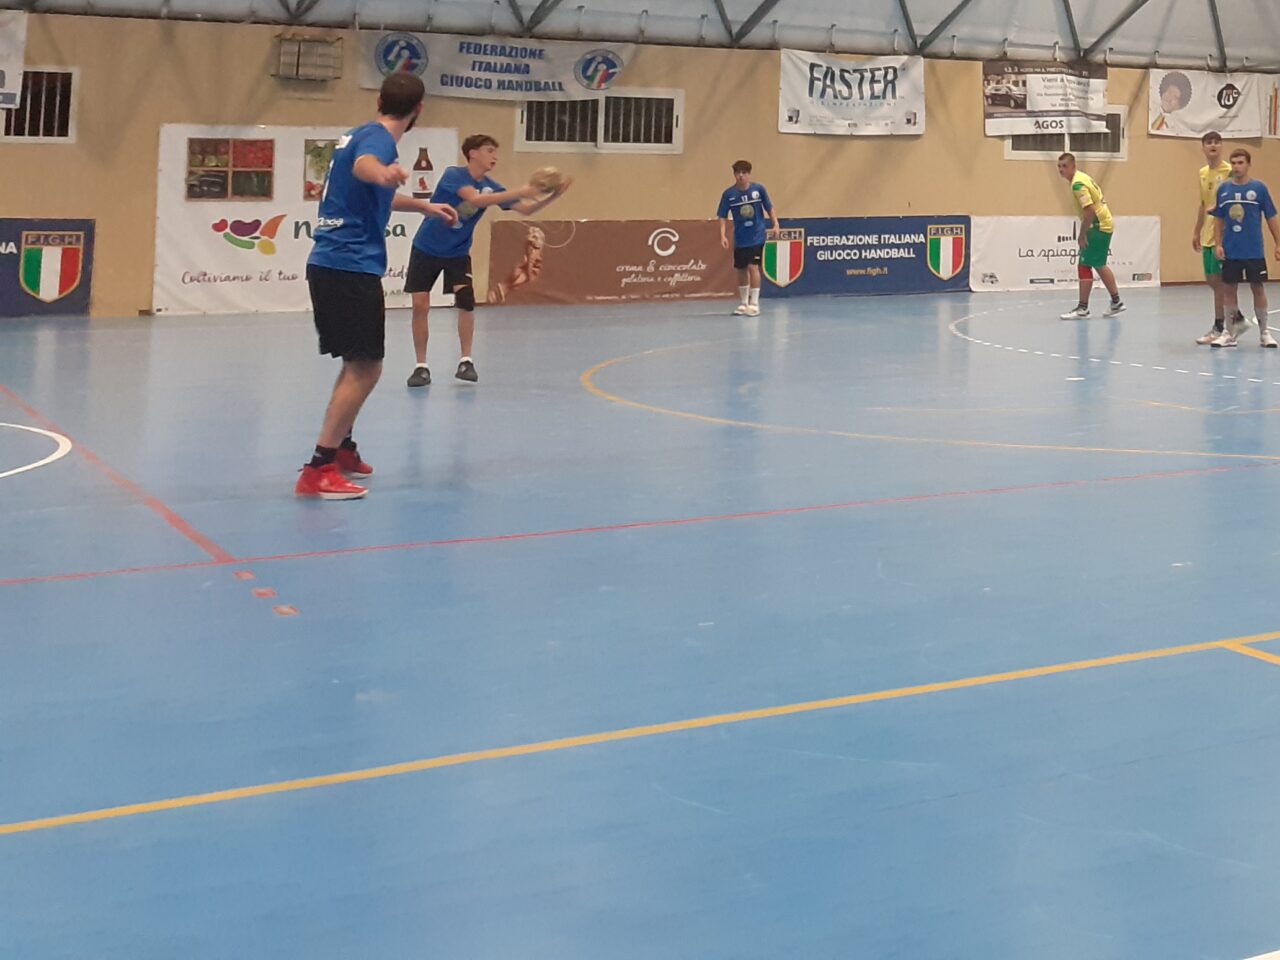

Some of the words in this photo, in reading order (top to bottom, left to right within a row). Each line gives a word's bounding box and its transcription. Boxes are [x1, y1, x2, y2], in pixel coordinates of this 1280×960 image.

[459, 41, 545, 59] FEDERAZIONE
[471, 60, 531, 74] ITALIANA
[441, 74, 492, 89] GIUOCO
[497, 79, 565, 91] HANDBALL
[808, 62, 898, 100] FASTER
[1033, 120, 1064, 129] AGOS
[807, 234, 878, 246] FEDERAZIONE
[881, 233, 925, 244] ITALIANA
[816, 249, 859, 261] GIUOCO
[862, 248, 915, 259] HANDBALL
[1018, 247, 1034, 258] La
[181, 271, 253, 284] Coltiviamo
[259, 269, 272, 282] il
[278, 270, 298, 281] tuo
[846, 267, 888, 276] www.figh.it
